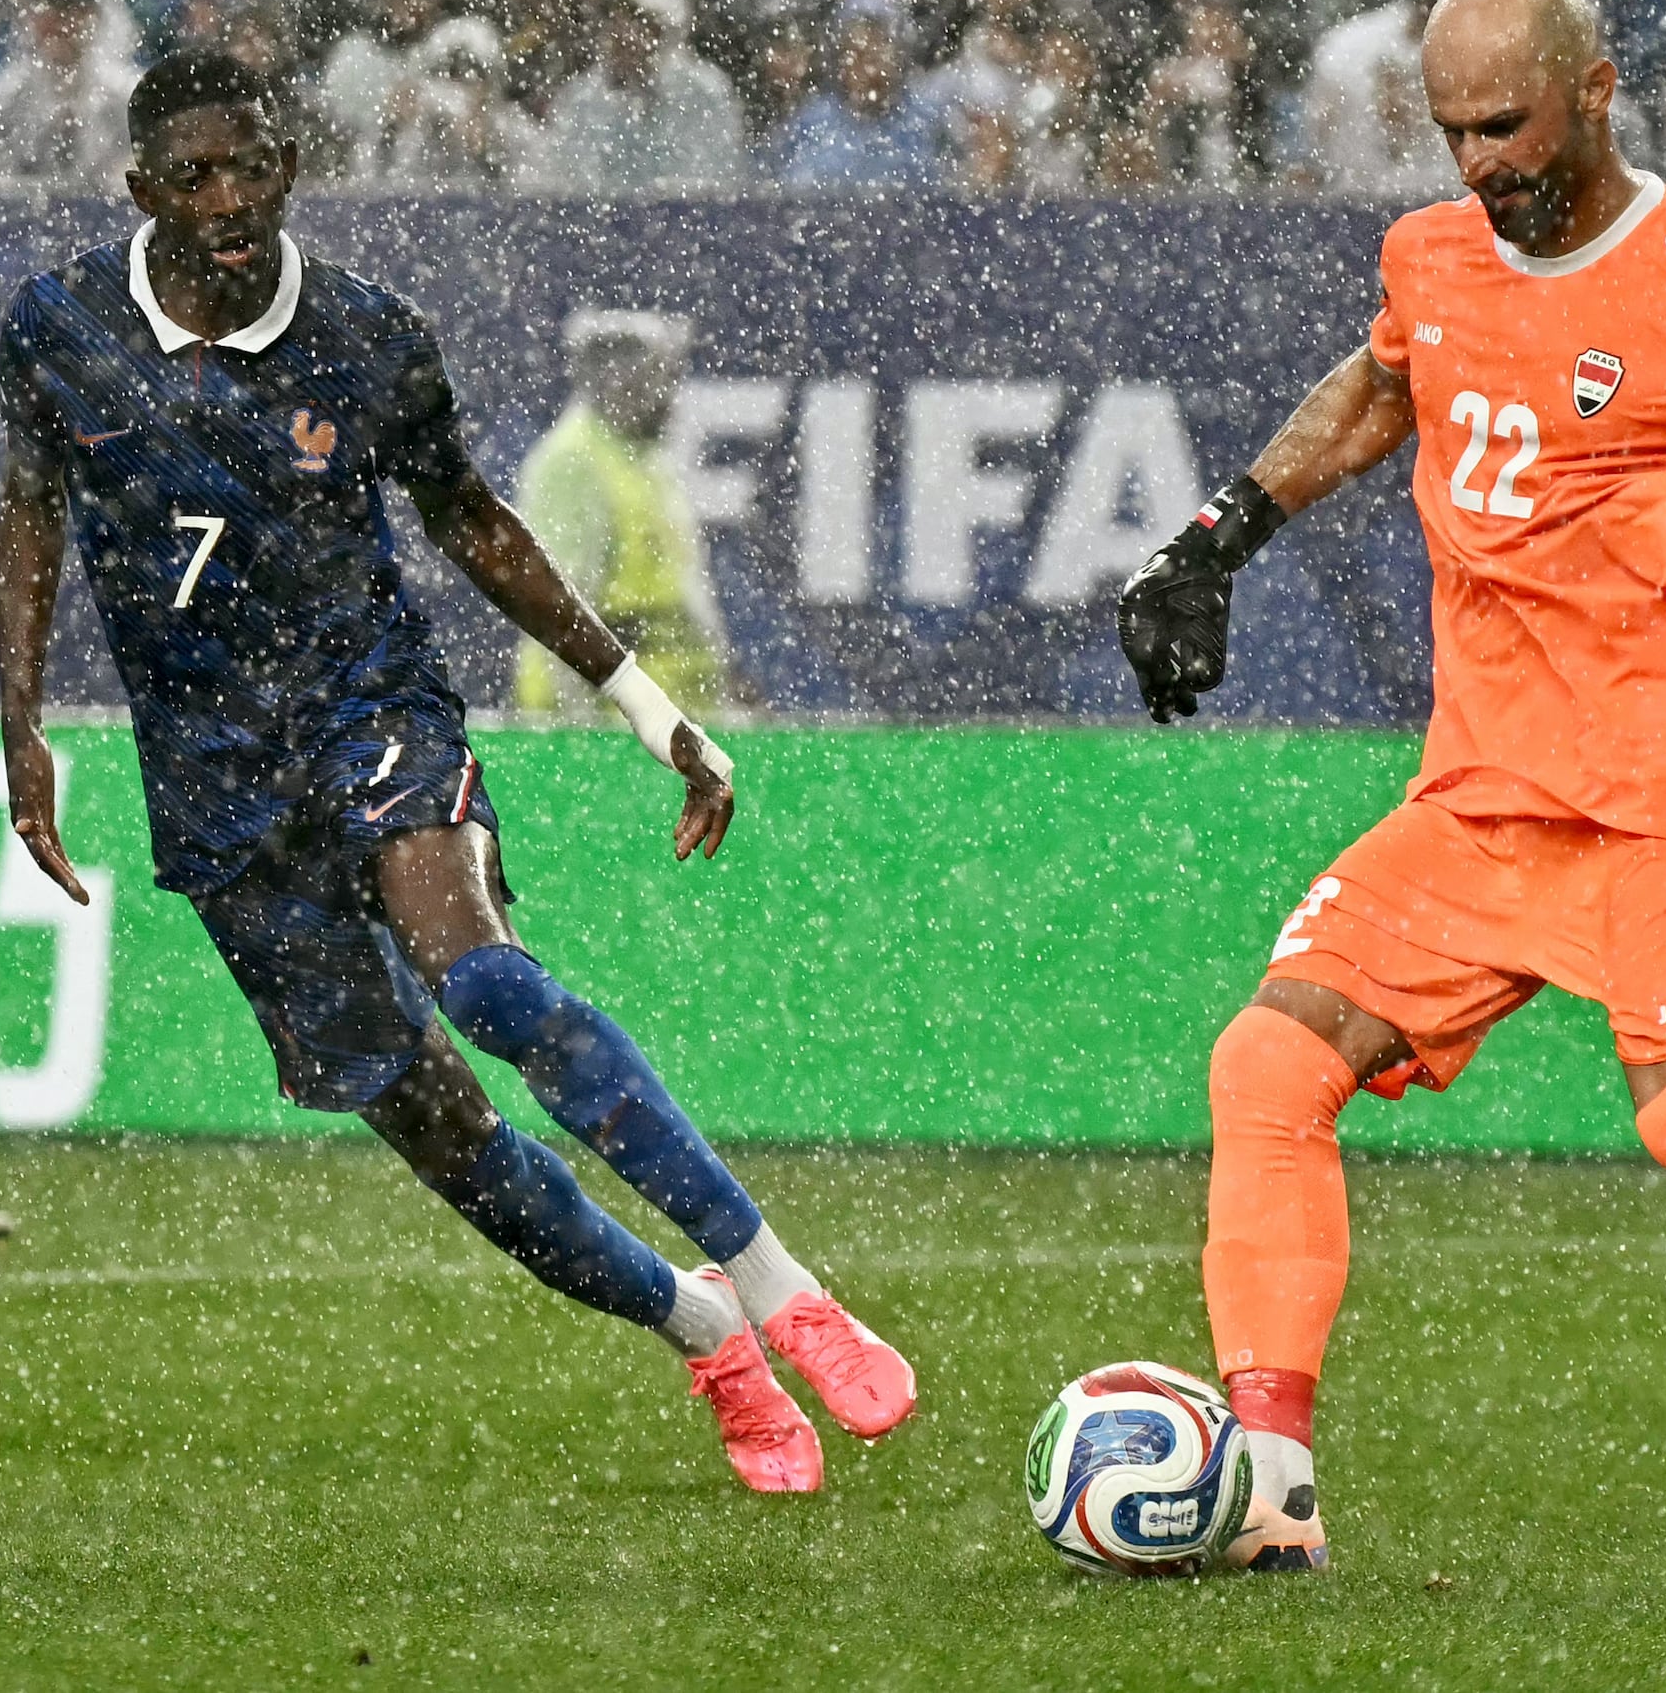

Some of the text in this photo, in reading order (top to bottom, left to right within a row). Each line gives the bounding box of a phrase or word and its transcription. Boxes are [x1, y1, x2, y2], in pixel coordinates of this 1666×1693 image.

[1413, 321, 1443, 346] JAKO
[1588, 352, 1617, 367] IRAQ
[668, 378, 1205, 606] FIFA
[1449, 390, 1541, 520] 22
[174, 515, 226, 609] 7
